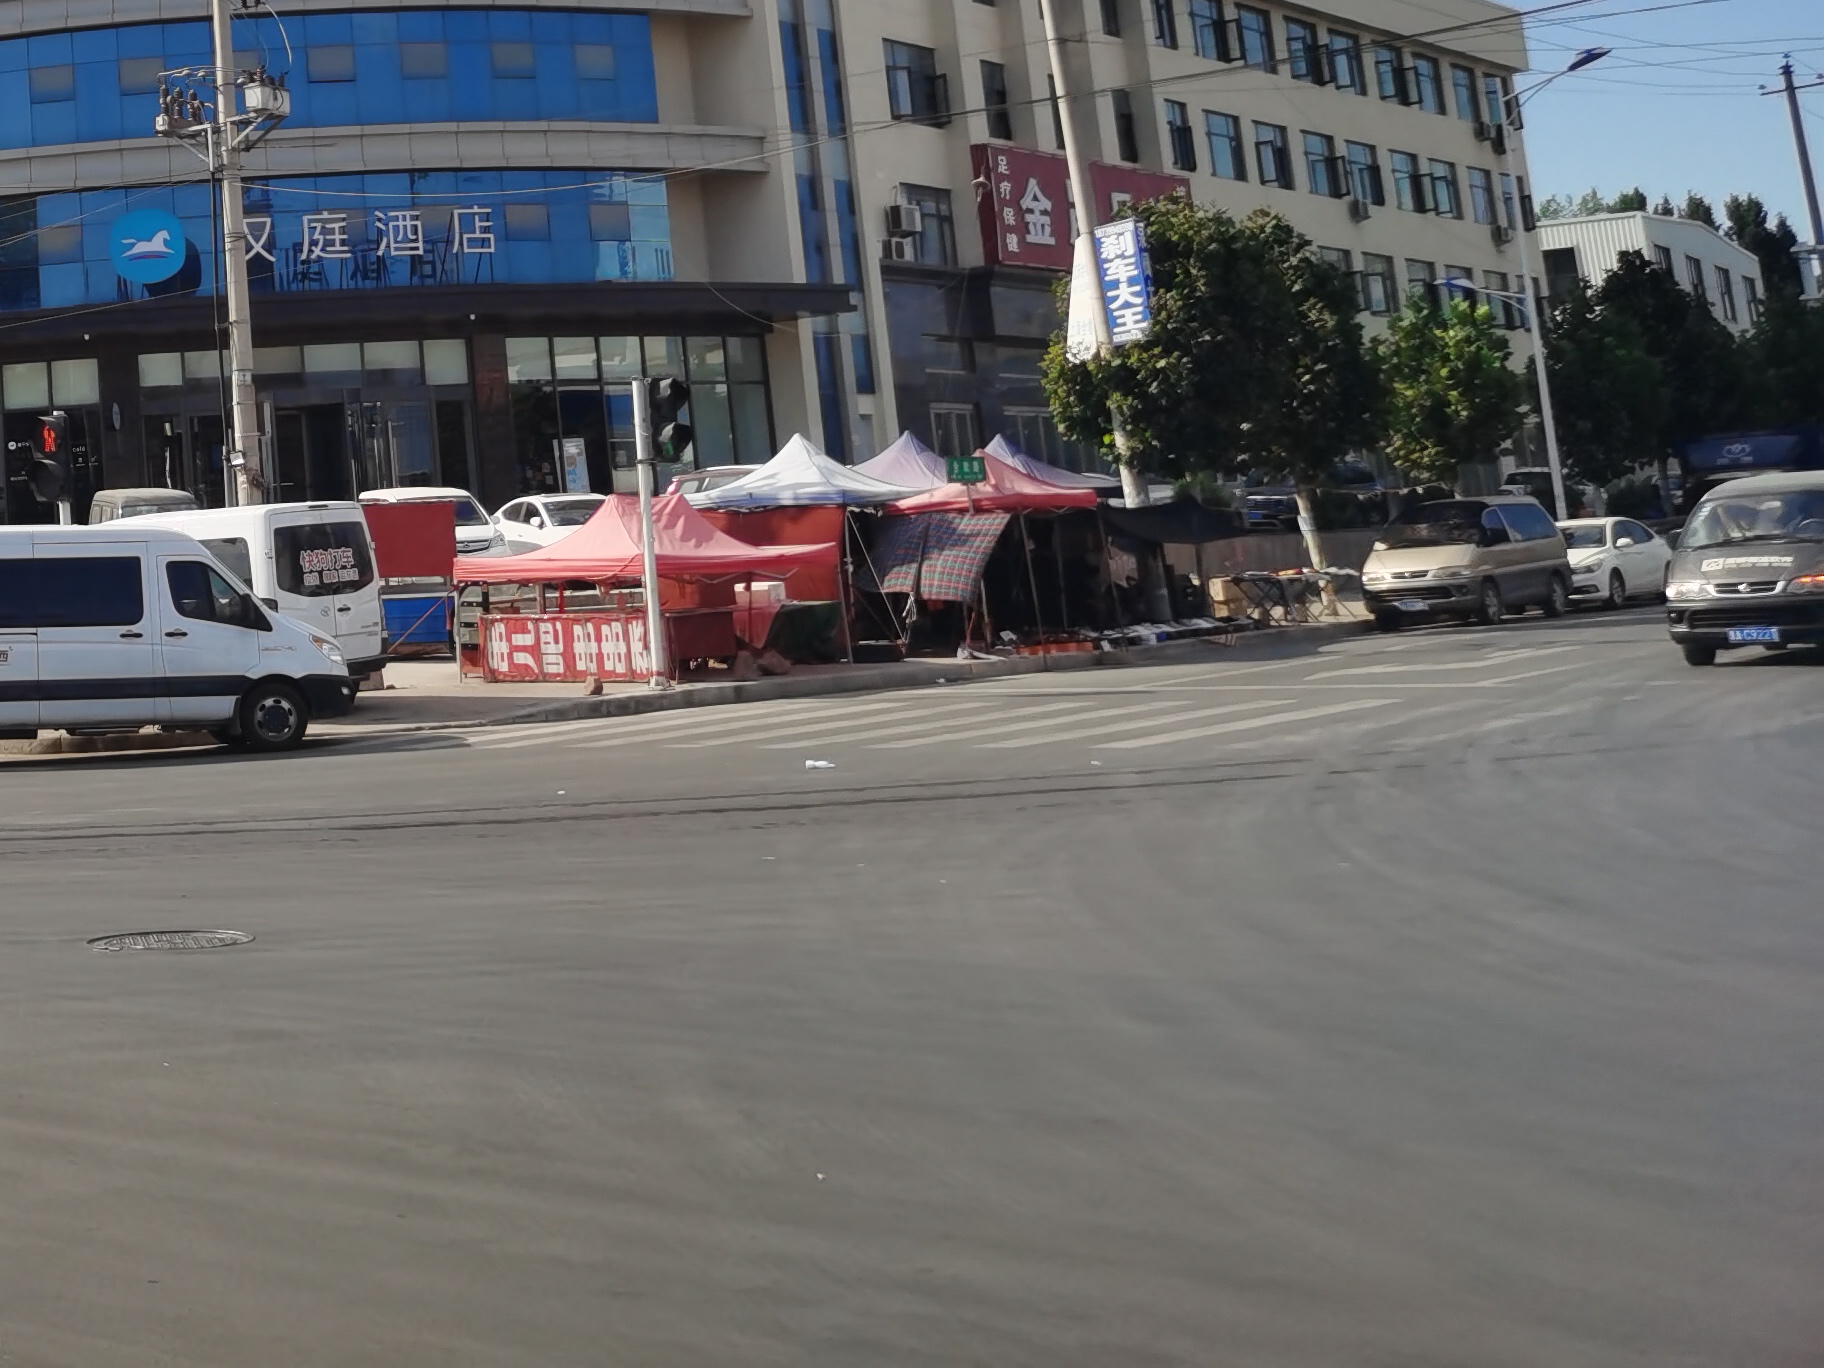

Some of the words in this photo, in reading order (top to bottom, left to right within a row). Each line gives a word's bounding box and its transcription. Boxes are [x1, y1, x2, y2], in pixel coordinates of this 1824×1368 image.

[997, 156, 1020, 253] 足疗保健
[1100, 231, 1148, 334] 刹车大王
[300, 547, 355, 572] 快狗打车
